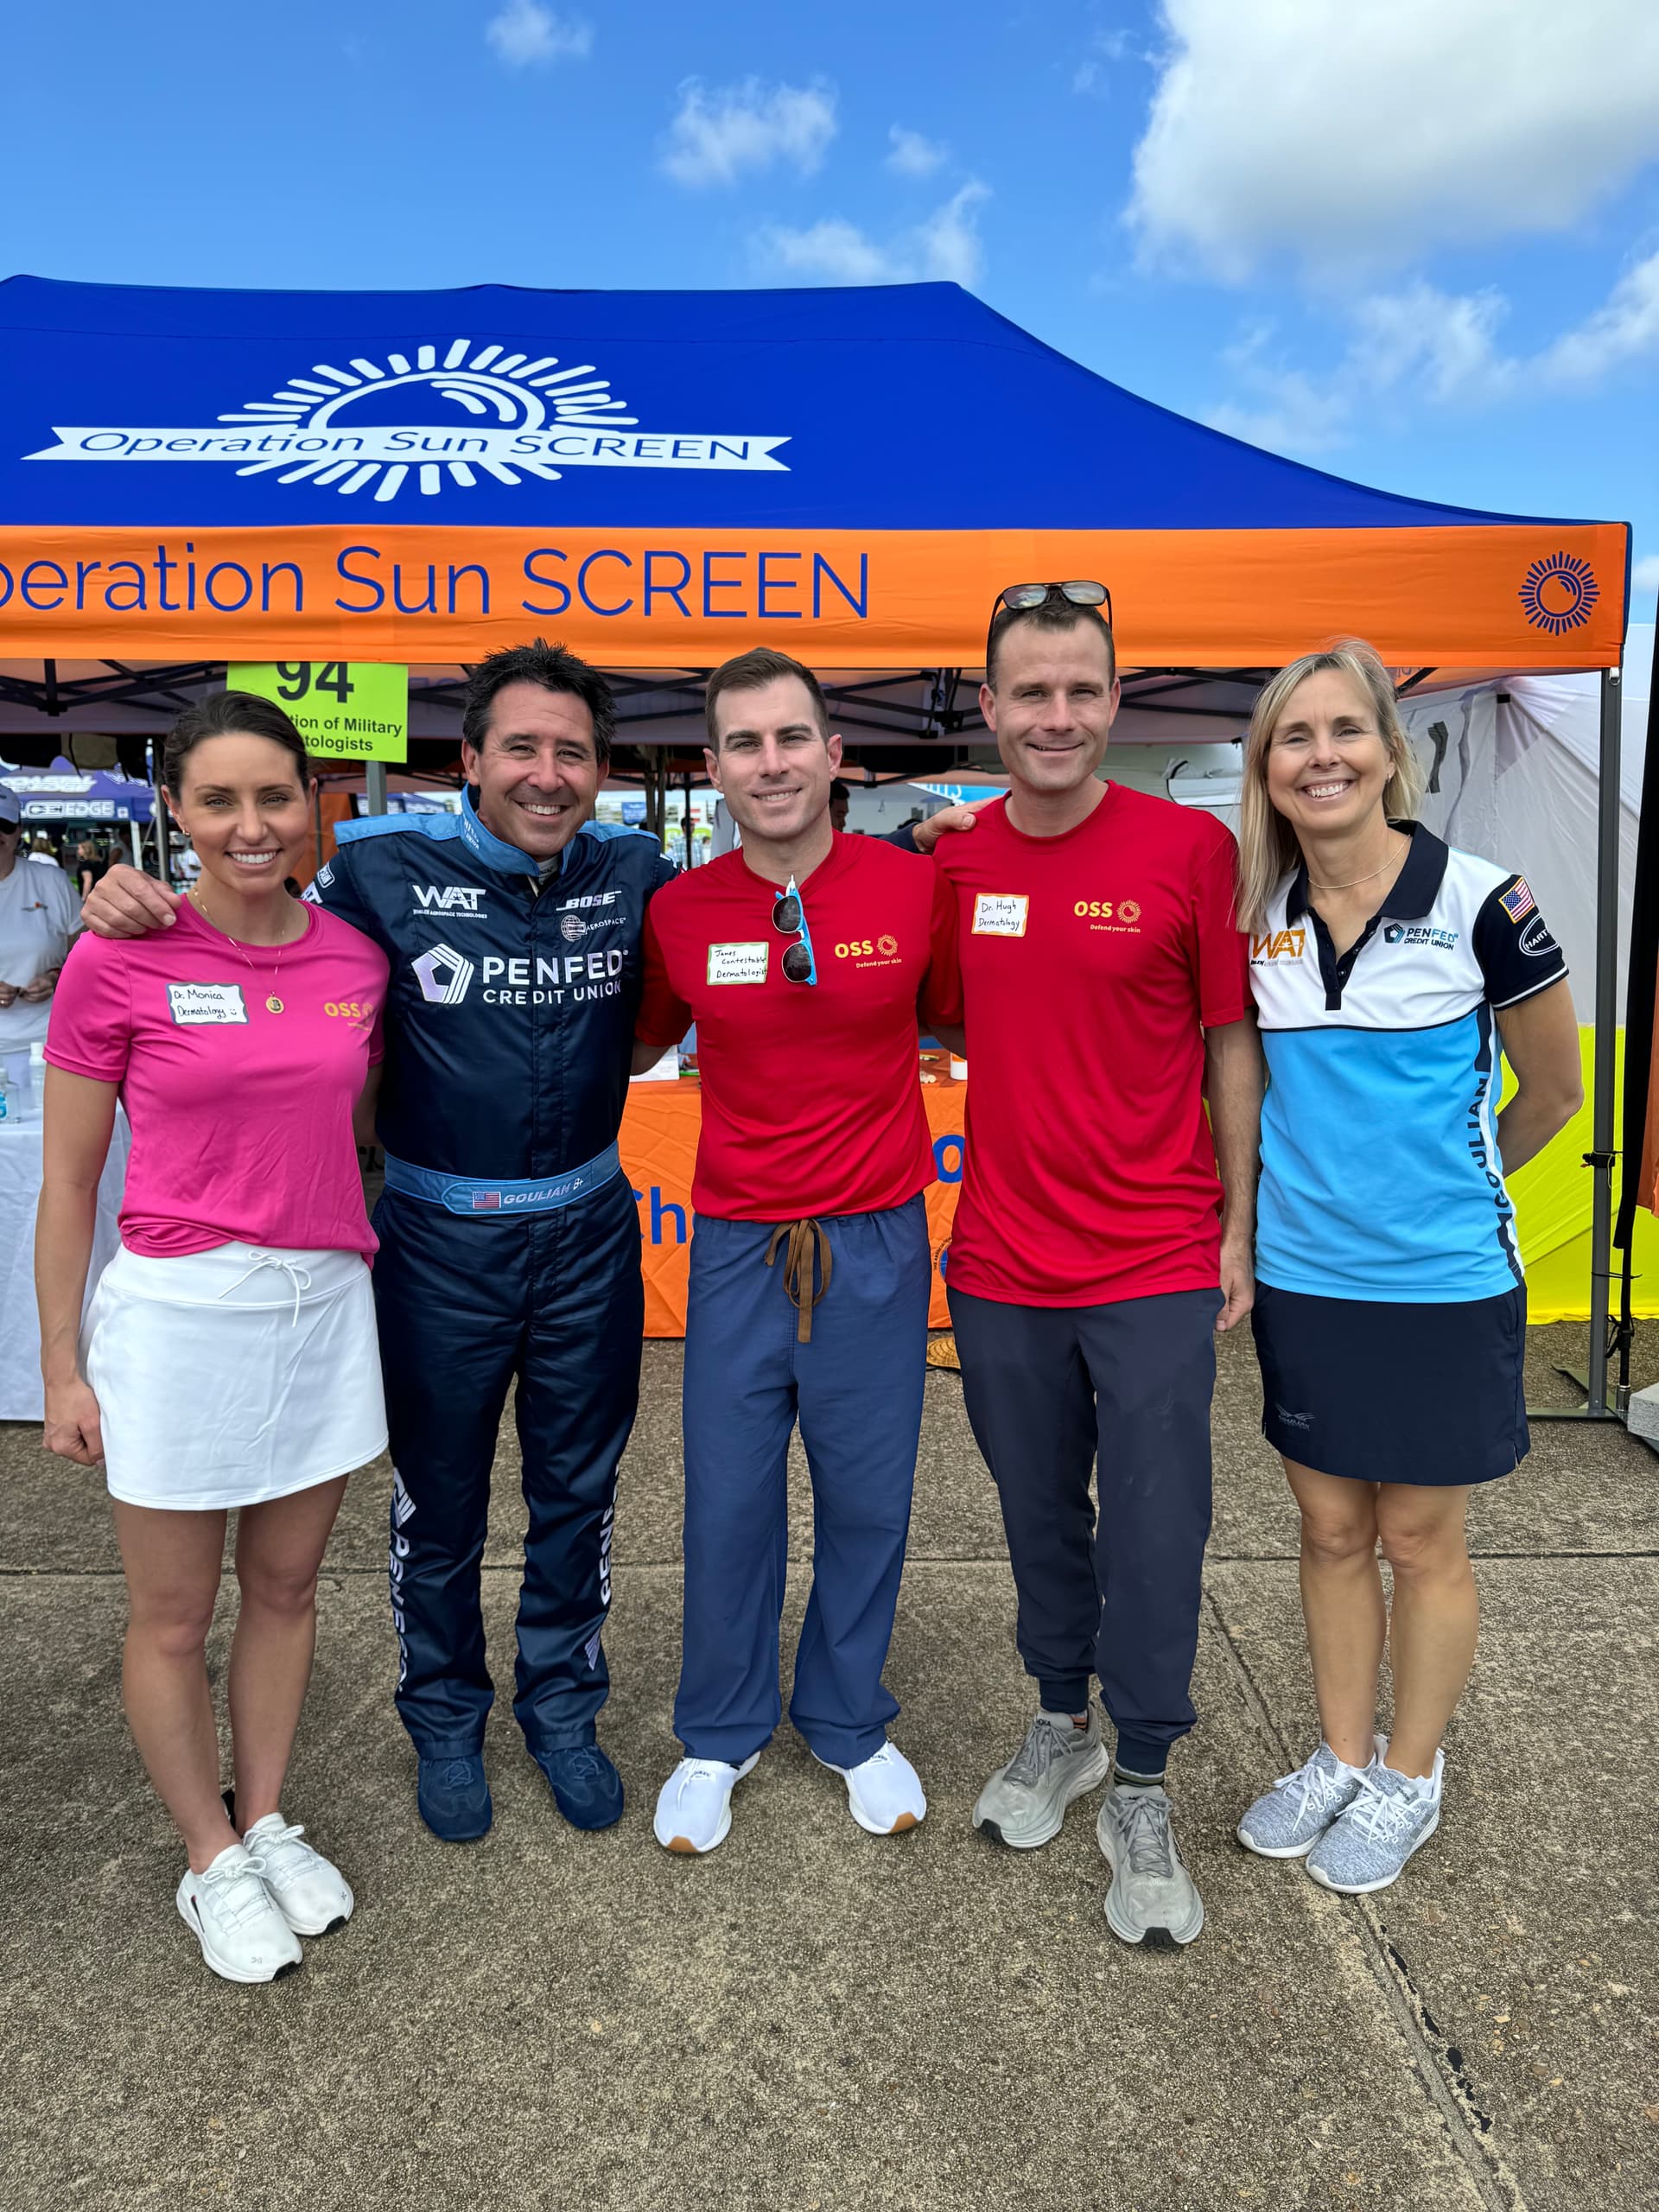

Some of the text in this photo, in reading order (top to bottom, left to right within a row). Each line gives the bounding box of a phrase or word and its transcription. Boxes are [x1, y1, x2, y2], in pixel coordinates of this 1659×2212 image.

[79, 431, 750, 461] Operation Sun SCREEN
[0, 542, 869, 619] eration Sun SCREEN
[276, 662, 354, 704] 94
[324, 717, 340, 730] of
[344, 717, 402, 738] Military
[412, 885, 486, 911] WAT
[556, 890, 622, 912] BOSE
[996, 899, 1016, 914] Hugh
[1074, 901, 1113, 918] OSS
[978, 917, 1020, 931] Dermatology
[1407, 928, 1455, 944] PENFED
[1431, 939, 1454, 950] UNION
[835, 940, 874, 958] OSS
[482, 950, 624, 986] PENFED
[855, 960, 877, 969] Defend
[877, 958, 890, 967] your
[187, 988, 225, 1000] Monica
[482, 980, 622, 1005] CREDIT UNION
[177, 1005, 226, 1019] Dermatology
[324, 1002, 361, 1018] OSS
[504, 1184, 570, 1205] GOULIAN
